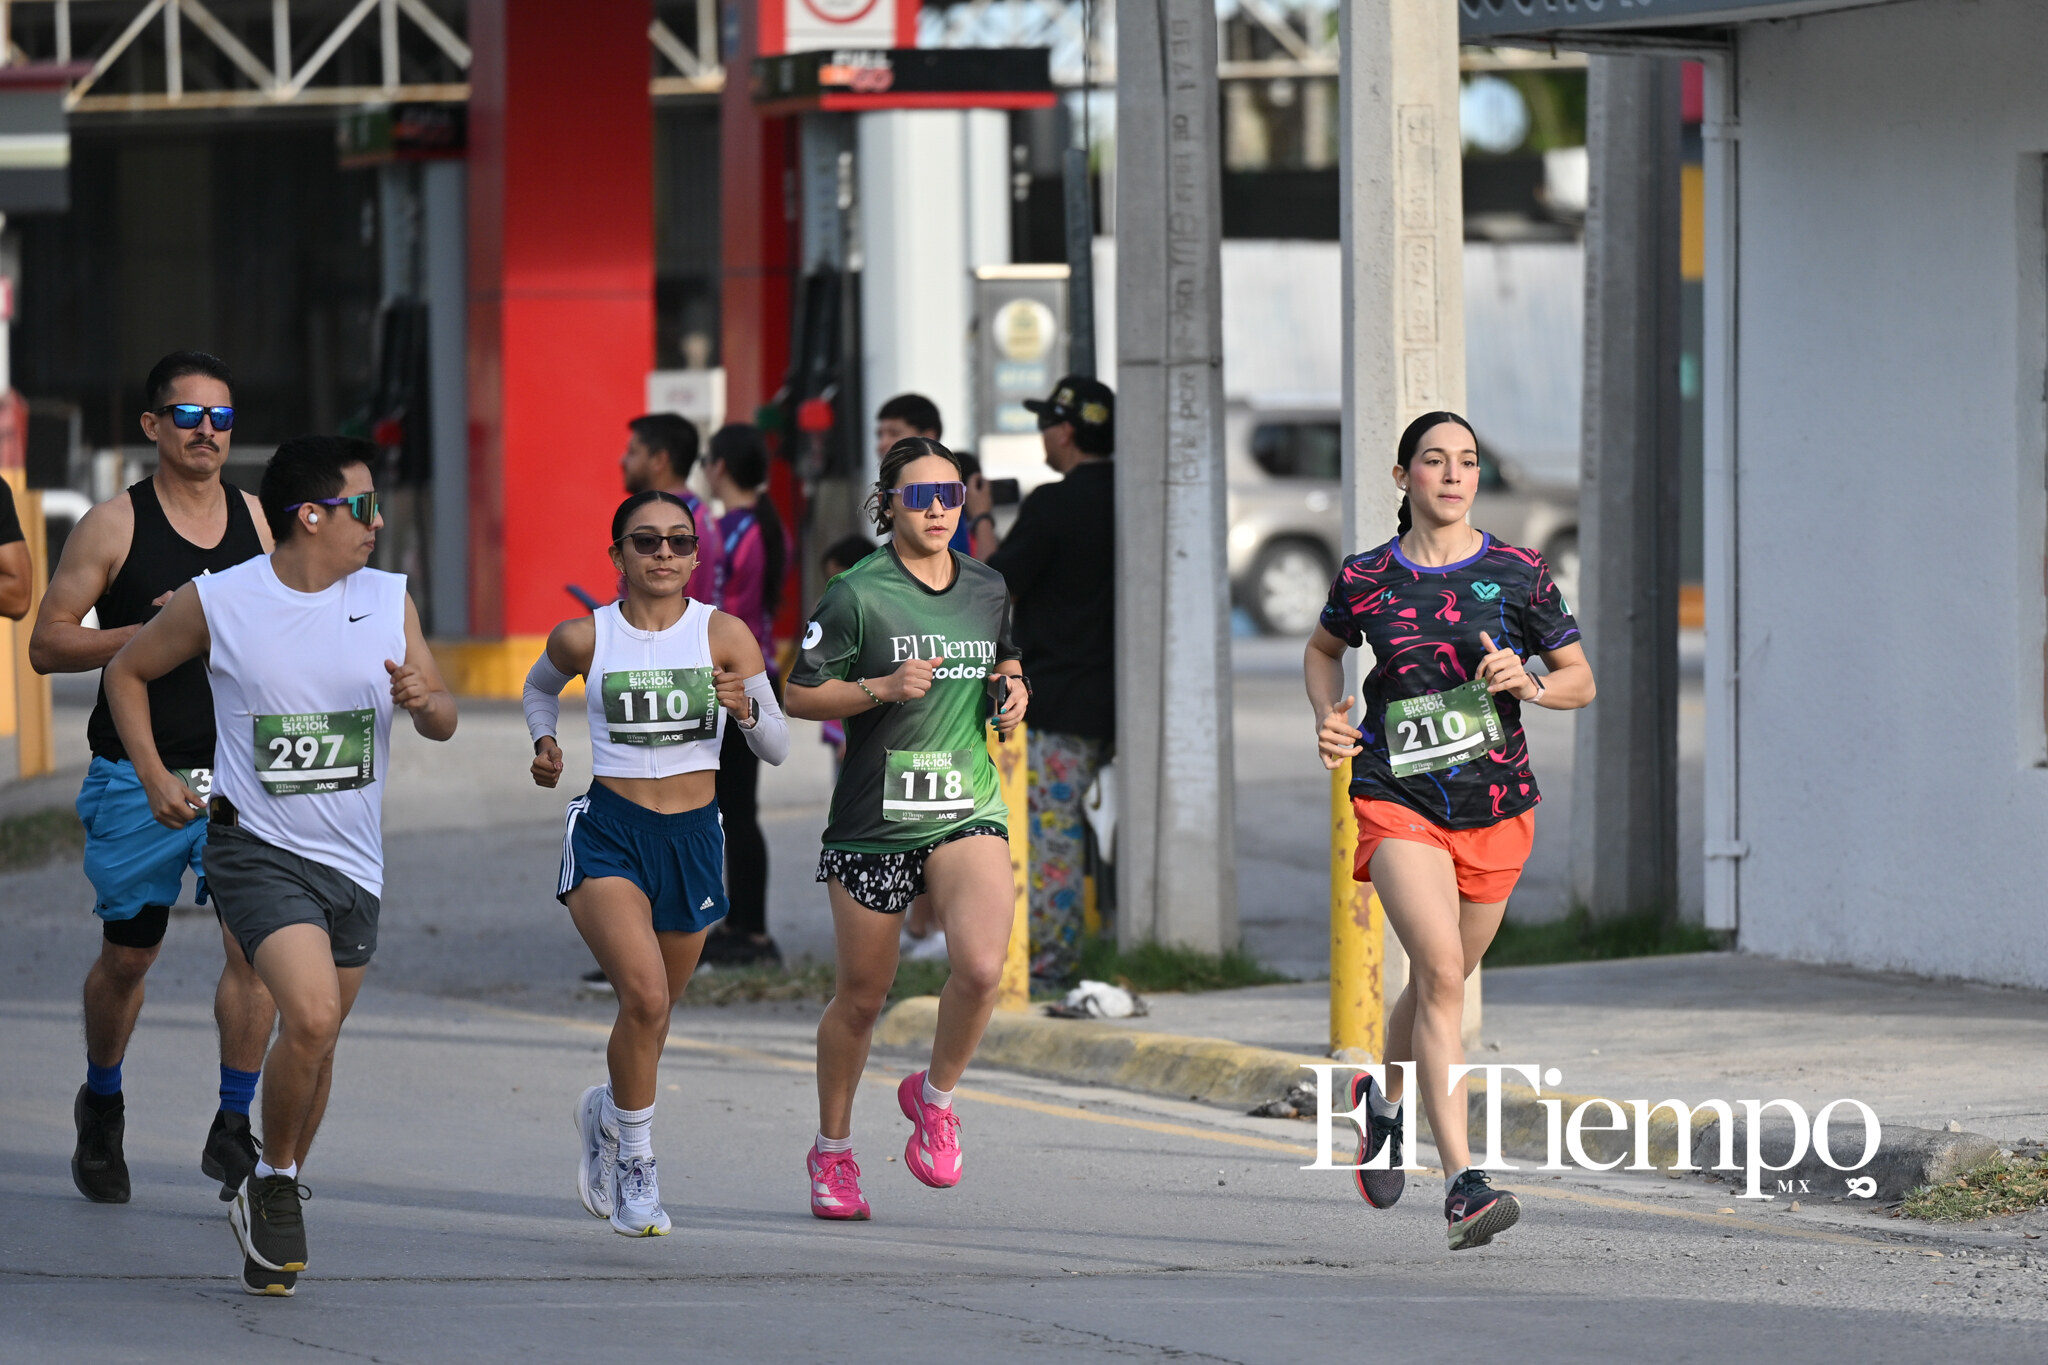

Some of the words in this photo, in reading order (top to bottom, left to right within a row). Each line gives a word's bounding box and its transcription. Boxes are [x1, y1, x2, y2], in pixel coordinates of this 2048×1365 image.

[890, 634, 919, 663] El
[921, 634, 997, 665] Tiempo
[1402, 694, 1443, 707] CARRERA
[1471, 682, 1487, 692] 210
[282, 715, 329, 723] CARRERA
[362, 714, 373, 722] 297
[619, 689, 689, 721] 110
[705, 684, 717, 730] MEDALLA
[1478, 693, 1501, 742] MEDALLA
[1397, 711, 1467, 752] 210
[268, 734, 345, 769] 297
[362, 727, 372, 779] MEDALLA
[901, 770, 963, 800] 118
